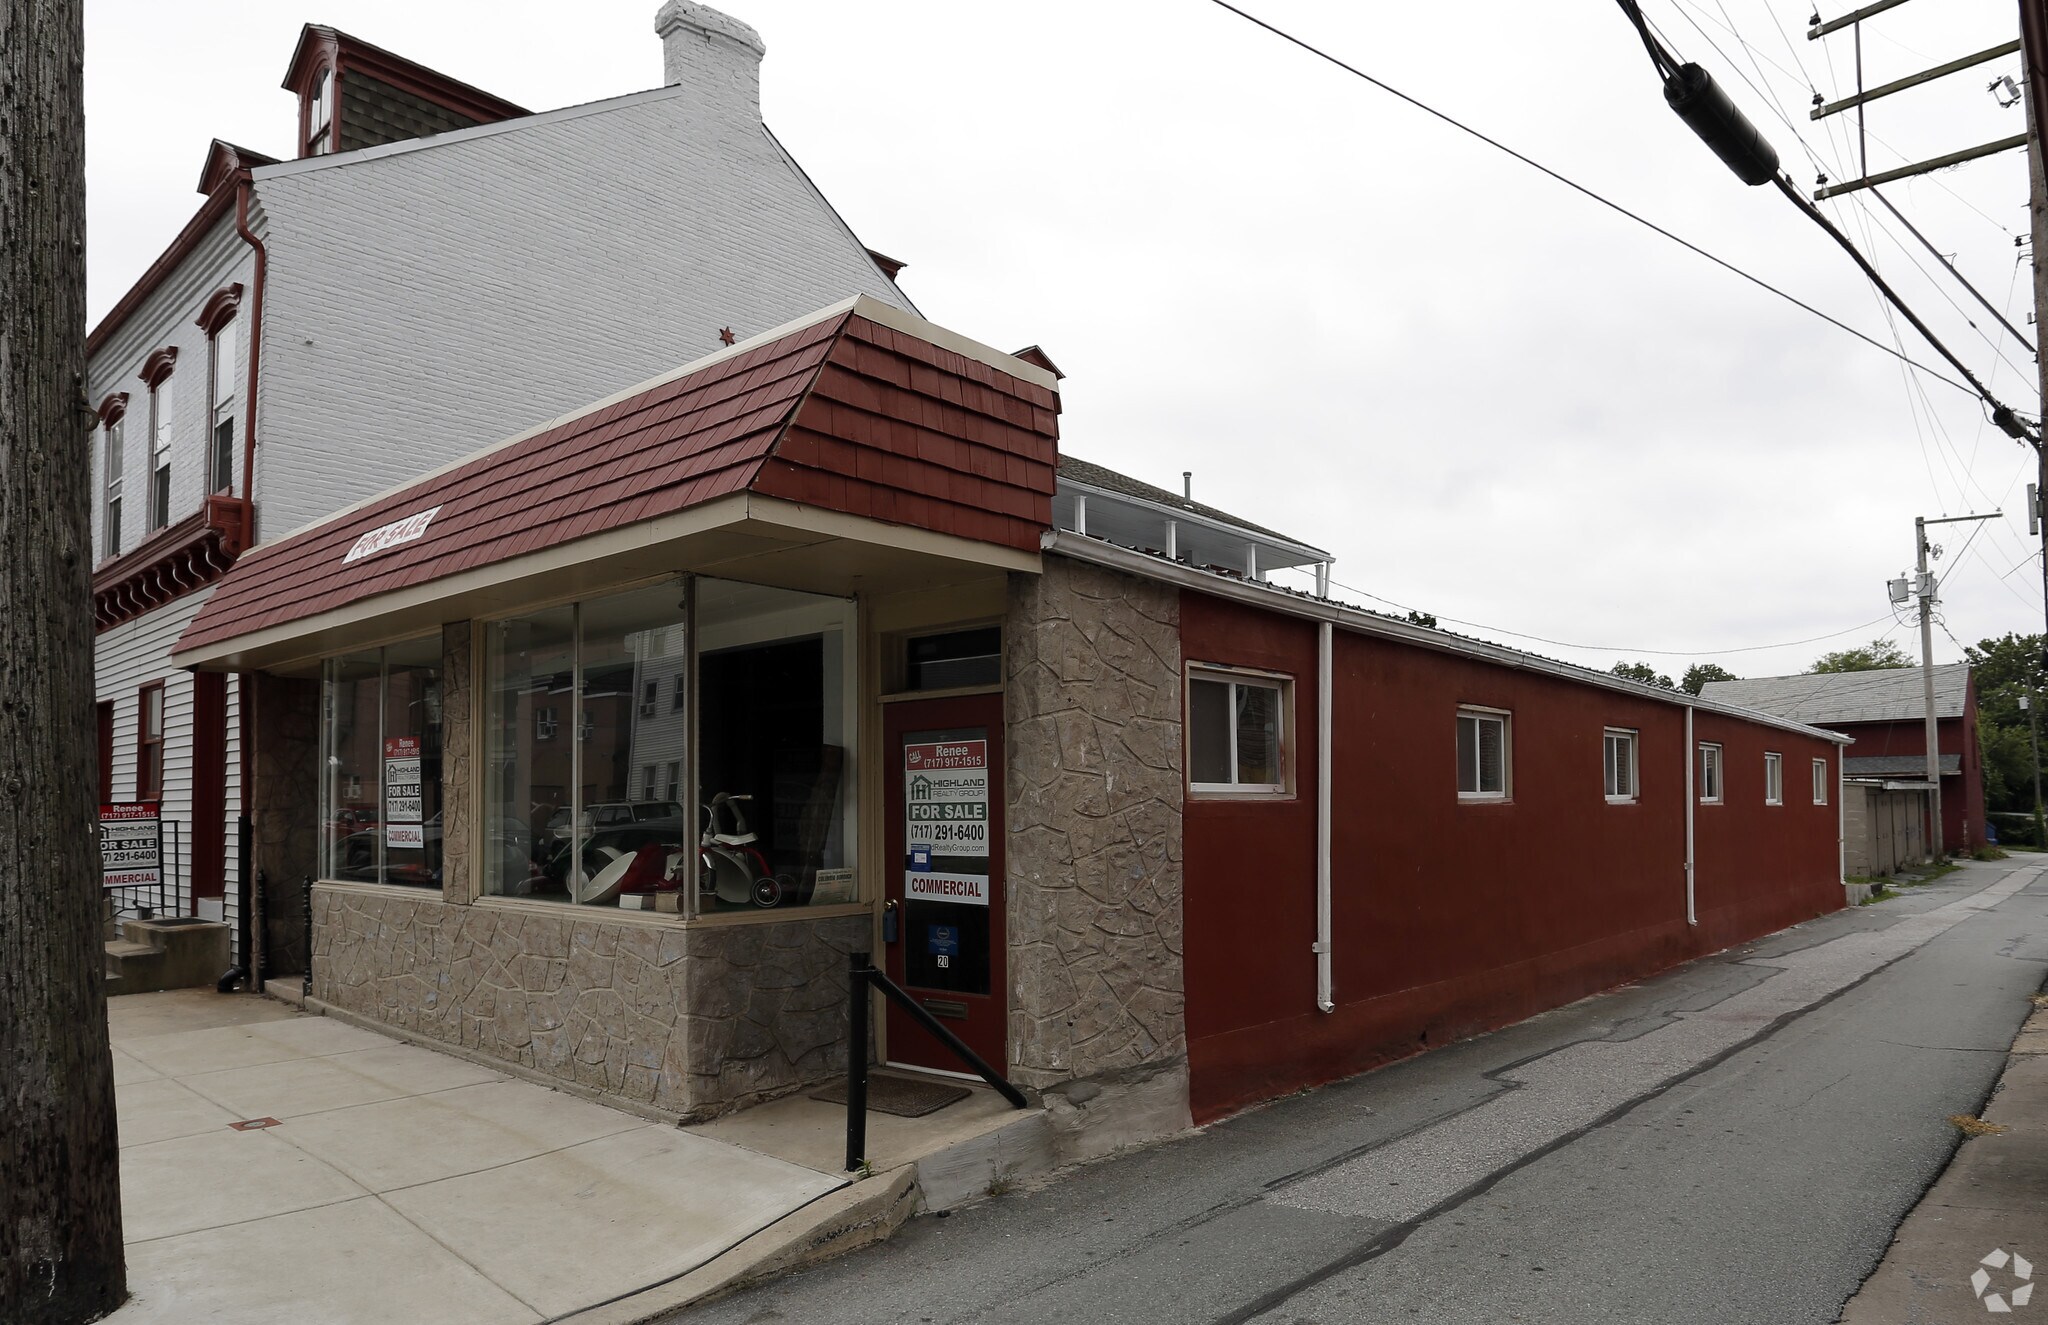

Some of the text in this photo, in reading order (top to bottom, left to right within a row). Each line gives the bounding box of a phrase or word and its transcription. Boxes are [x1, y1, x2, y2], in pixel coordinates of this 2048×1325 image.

[351, 513, 432, 556] FOR SALE
[399, 738, 414, 748] Renee
[909, 750, 922, 762] CALL
[936, 745, 968, 757] Renee
[924, 756, 981, 768] (717) 917-1515
[933, 778, 985, 787] HIGHLAND
[388, 785, 420, 796] FOR SALE
[933, 789, 958, 798] REALTY
[959, 789, 984, 797] GROUP
[113, 805, 144, 813] Renee
[912, 804, 983, 819] FOR SALE
[101, 811, 156, 820] (717) 917-1515
[389, 830, 422, 842] COMMERCIAL
[911, 824, 984, 841] (717) 291-6400
[100, 839, 155, 850] OR SALE
[931, 843, 985, 853] dRealtyGroup.com
[113, 850, 156, 862] 291-6400
[105, 873, 157, 885] MMERCIAL
[912, 877, 982, 897] COMMERCIAL
[938, 956, 948, 967] 20
